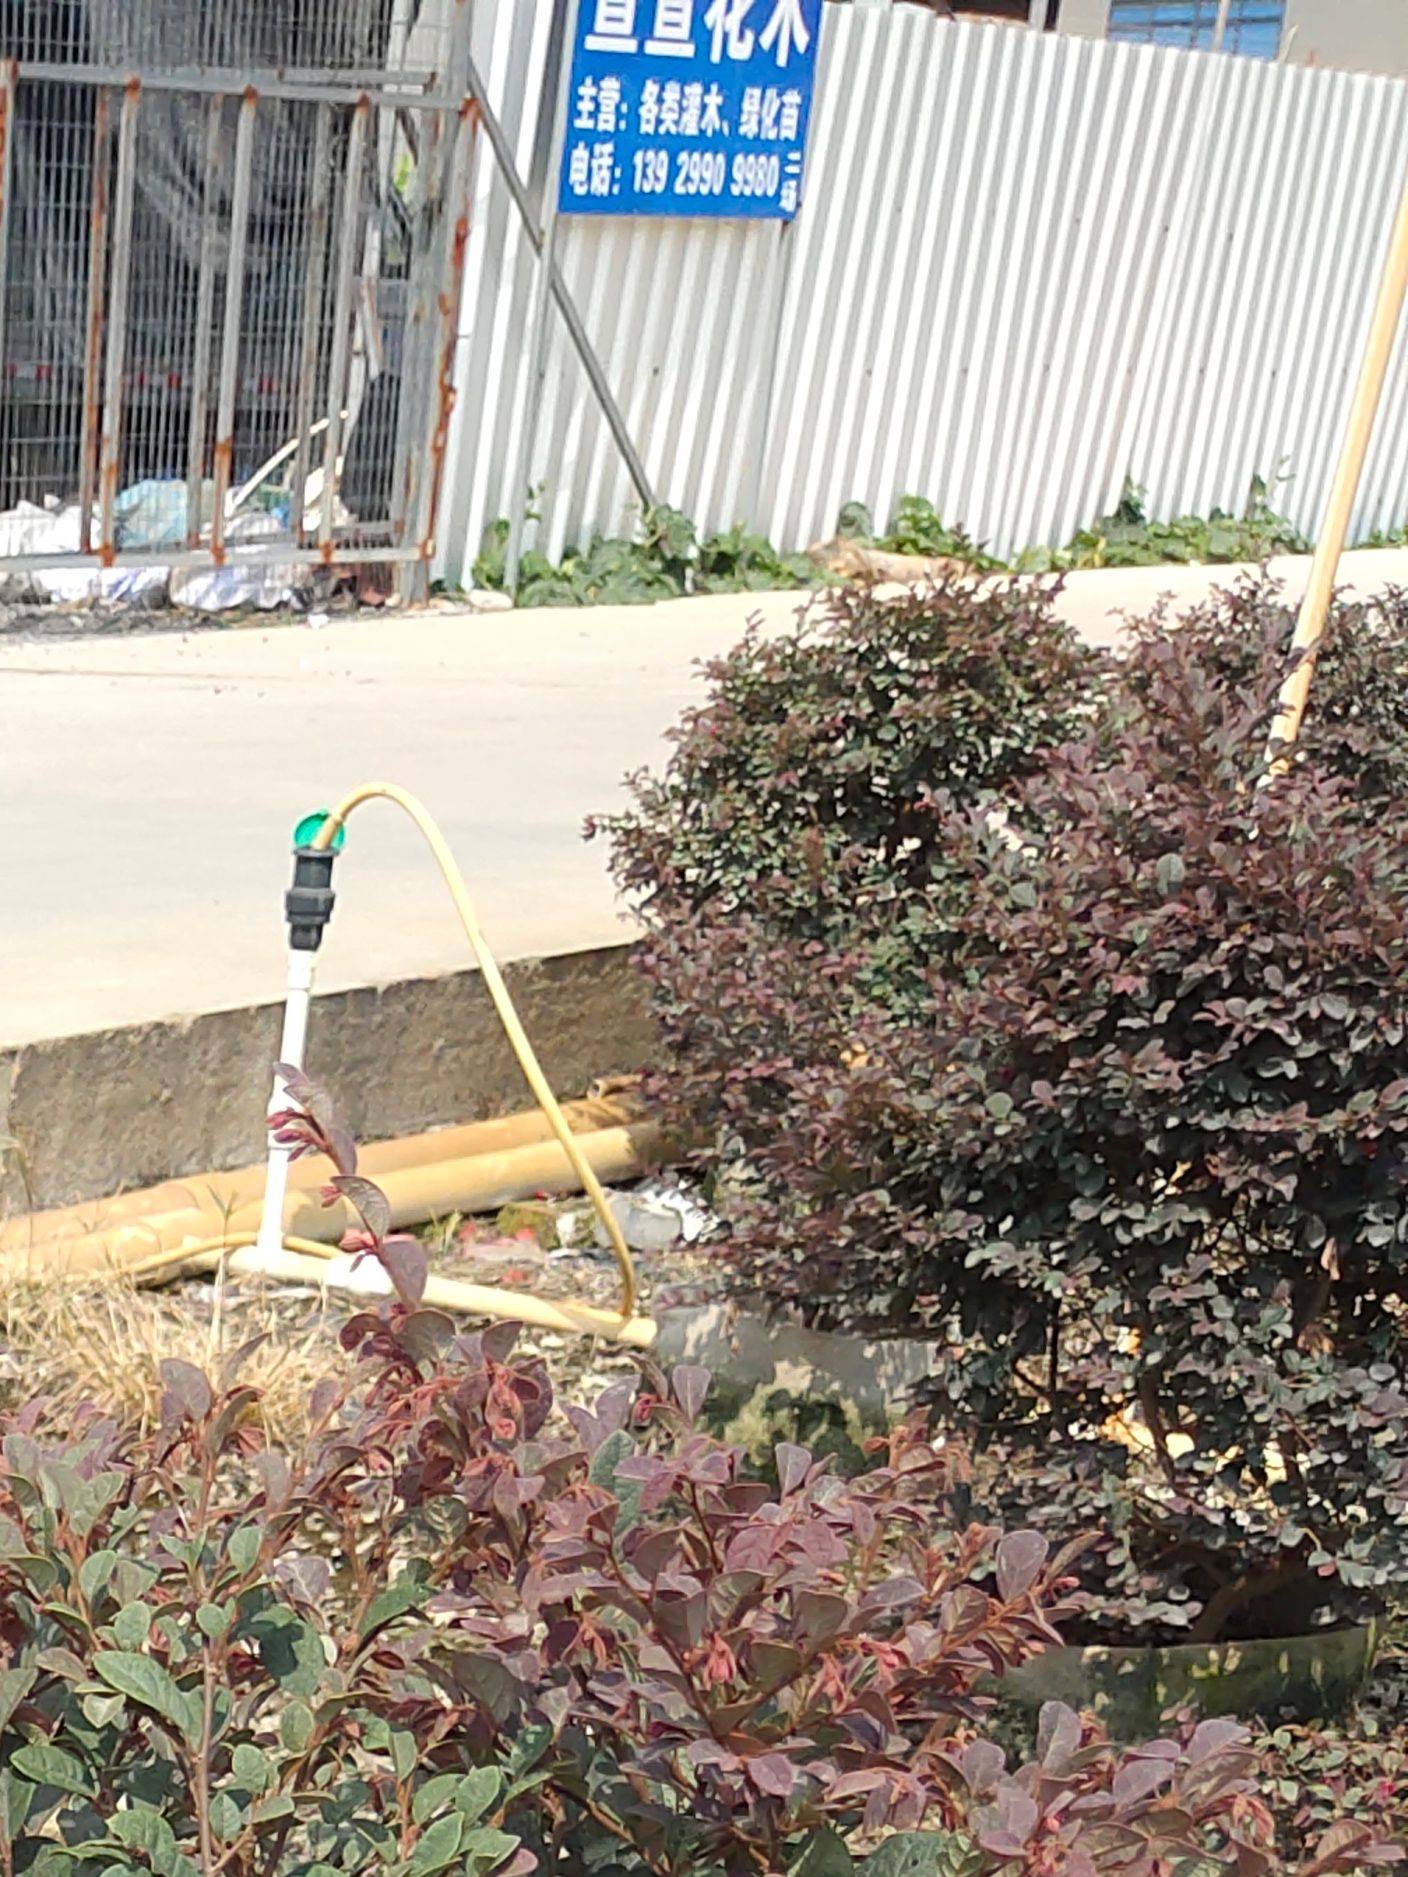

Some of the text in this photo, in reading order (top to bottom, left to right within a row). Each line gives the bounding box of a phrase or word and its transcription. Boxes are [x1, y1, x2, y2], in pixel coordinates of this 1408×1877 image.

[633, 148, 669, 194] 139
[674, 152, 725, 196] 2990
[731, 154, 780, 198] 9980
